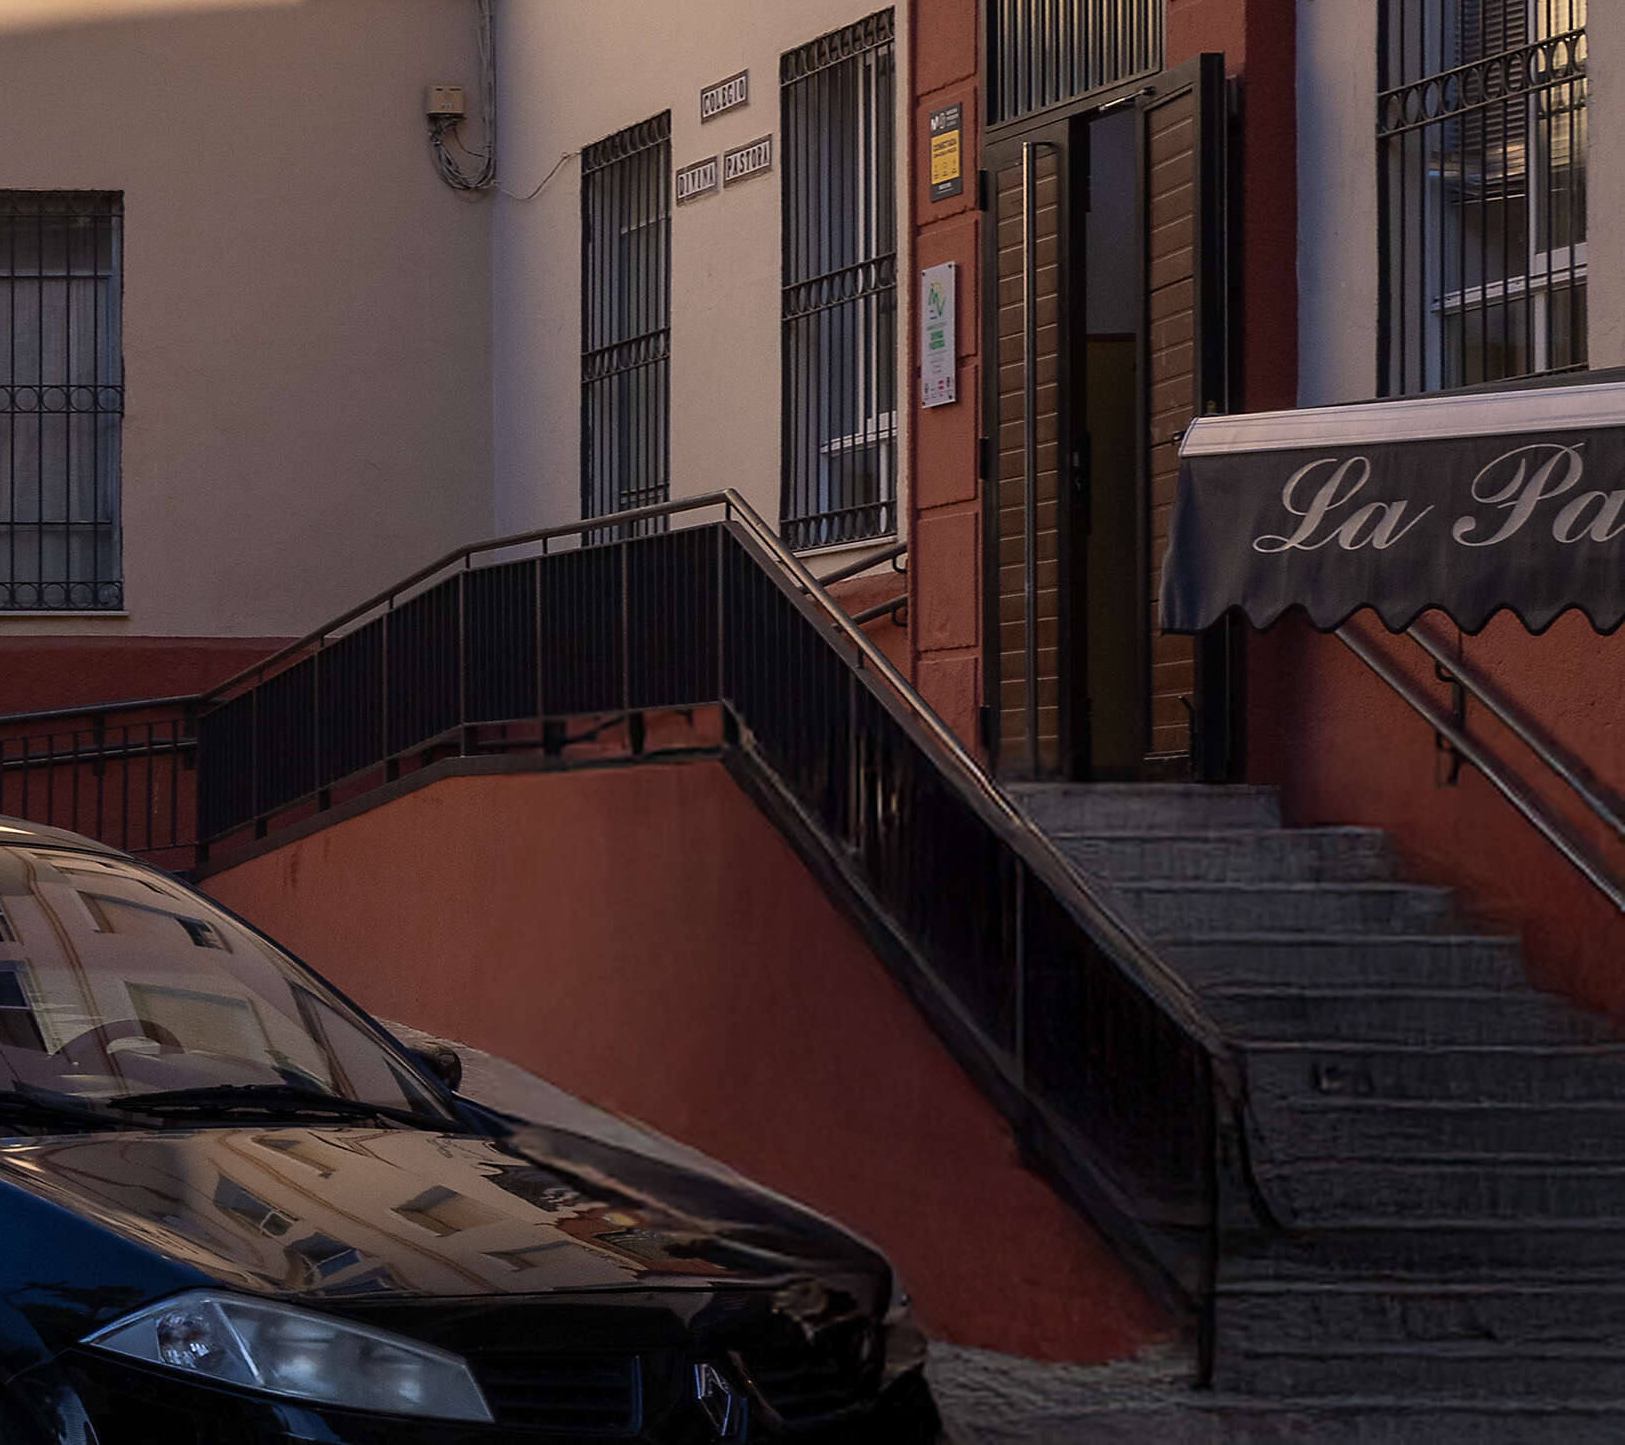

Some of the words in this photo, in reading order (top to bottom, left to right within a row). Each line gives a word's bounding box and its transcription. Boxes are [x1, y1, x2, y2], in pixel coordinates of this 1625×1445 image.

[703, 77, 745, 115] COLEGIO
[678, 163, 714, 196] DIVINA
[726, 144, 767, 178] PASTORA
[1252, 456, 1435, 553] La
